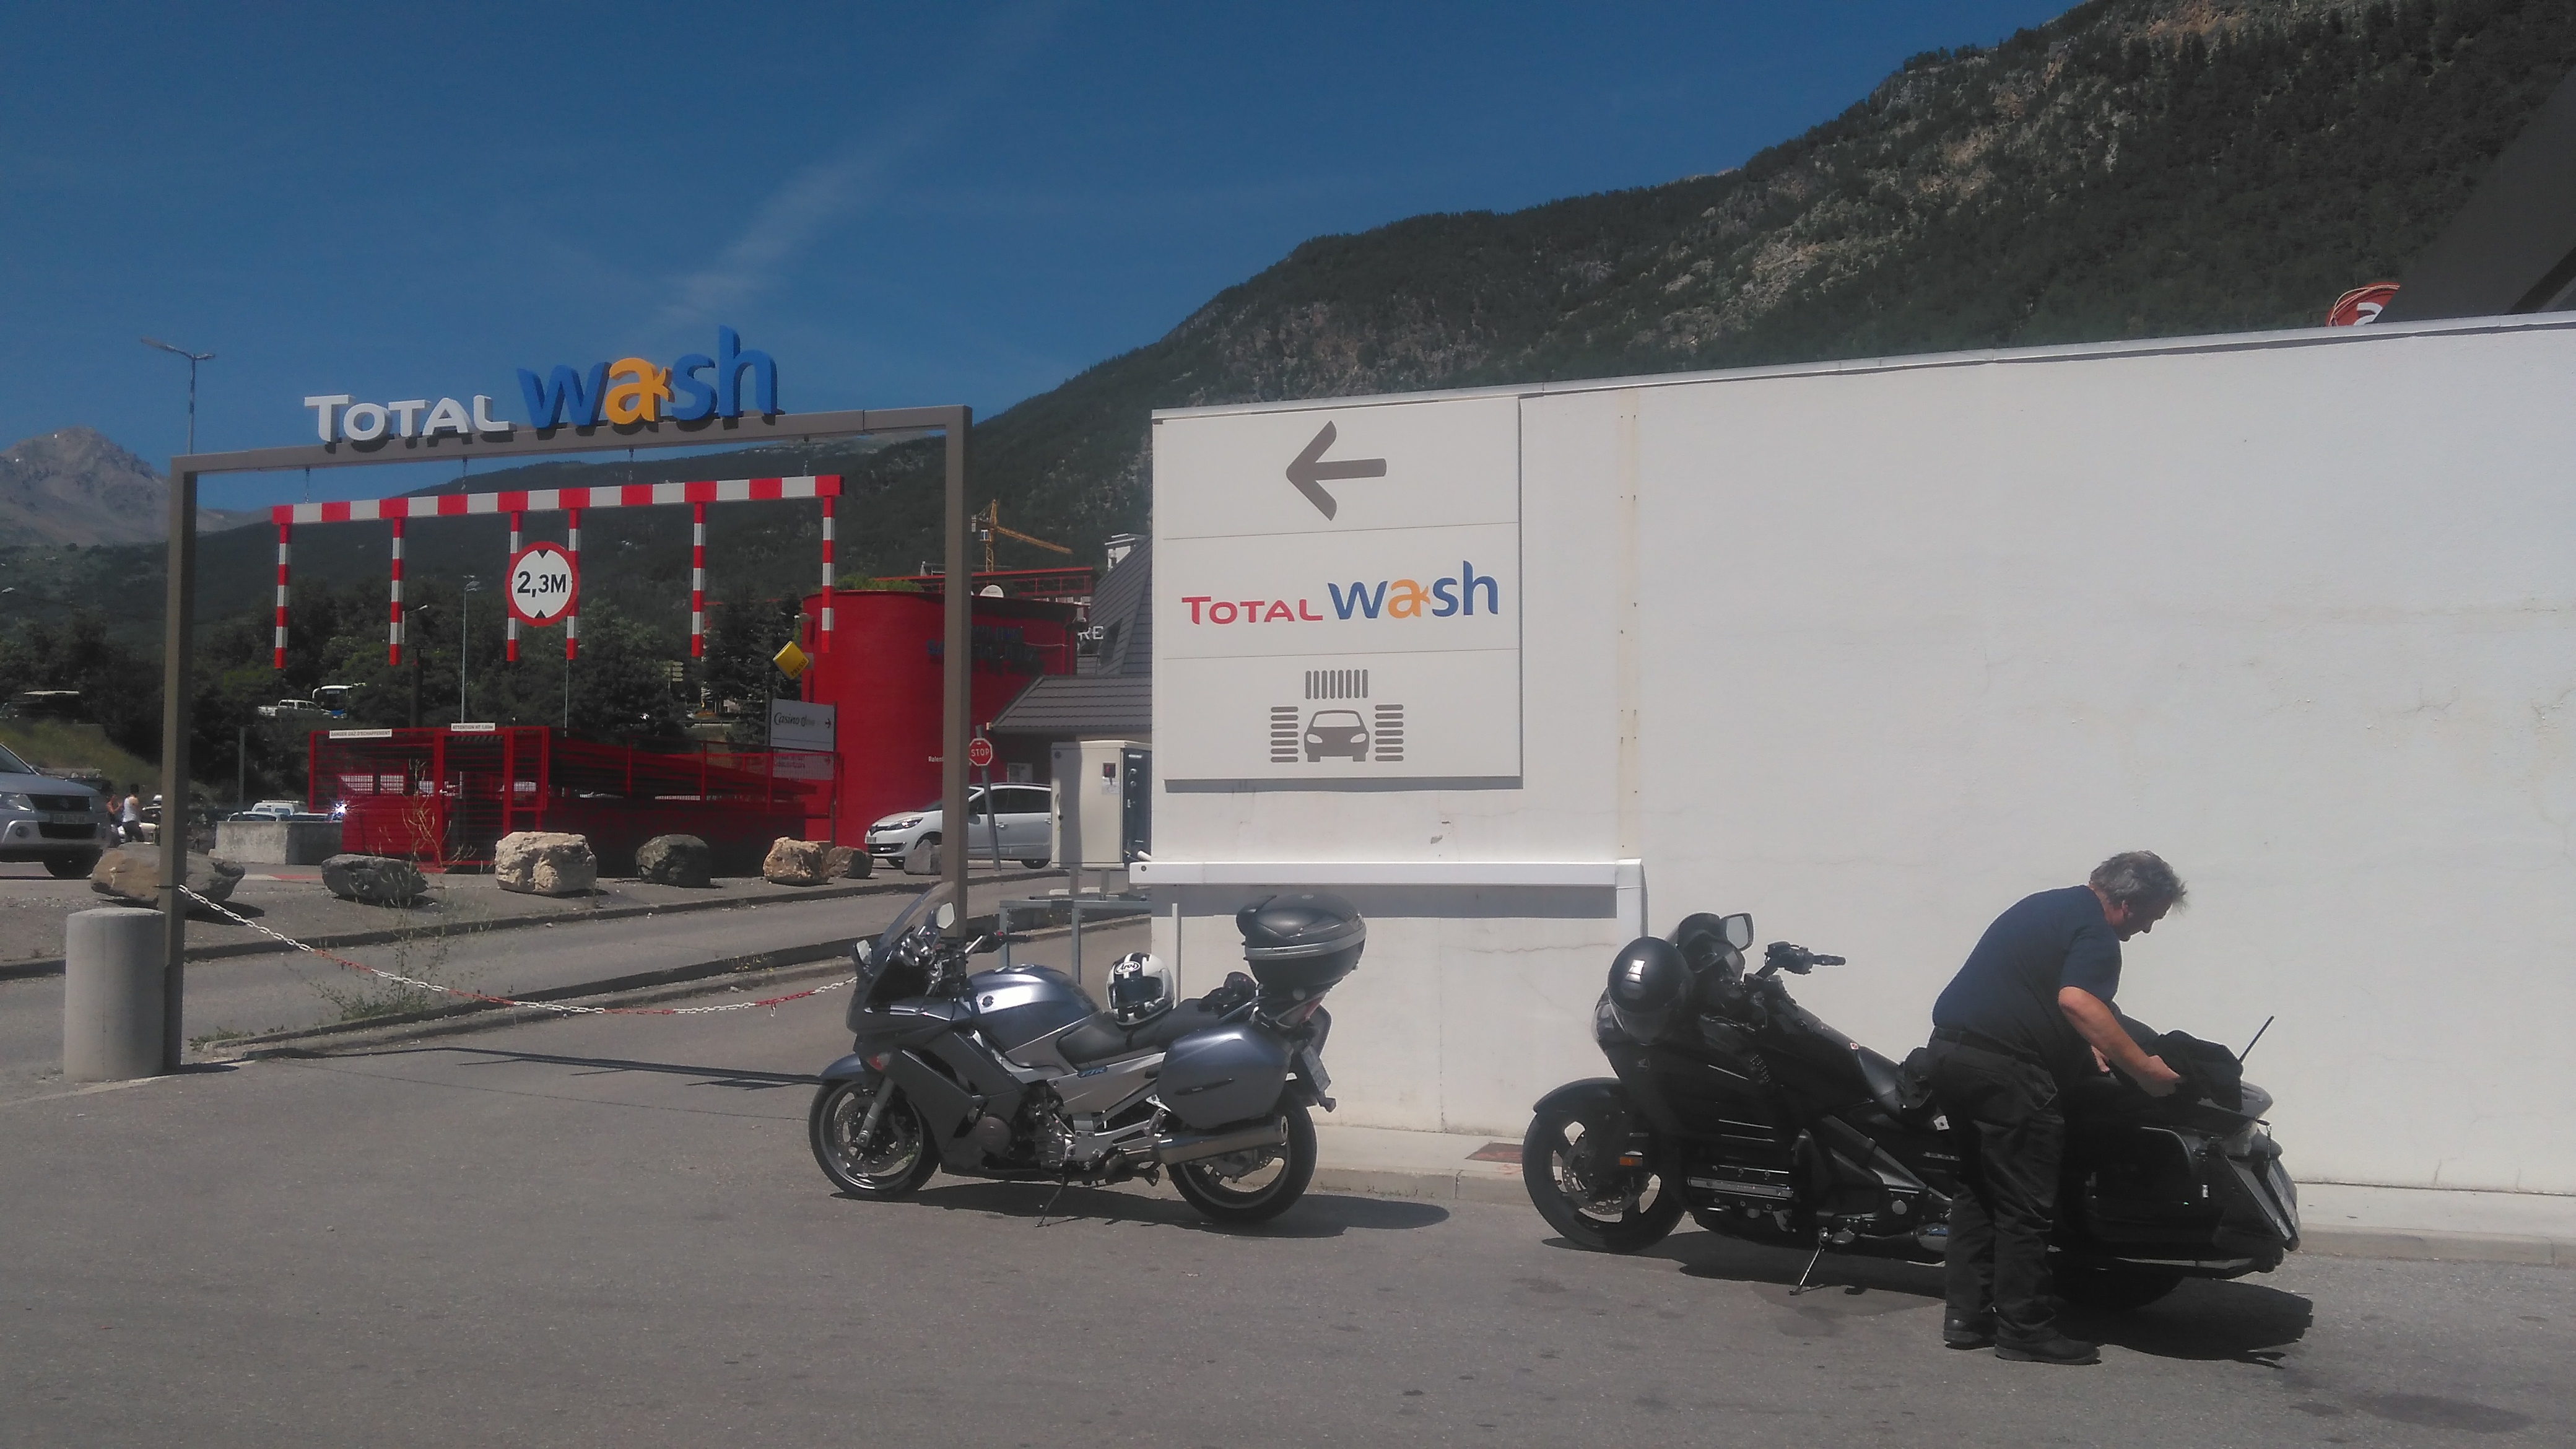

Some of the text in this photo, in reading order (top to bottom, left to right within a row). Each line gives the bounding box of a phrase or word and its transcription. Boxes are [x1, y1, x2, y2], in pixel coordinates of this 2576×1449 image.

[304, 325, 777, 443] TOTAL wash
[517, 570, 566, 598] 2,3M
[1181, 560, 1499, 625] TOTAL wash
[790, 658, 807, 676] PRESSE
[774, 712, 800, 726] Casino
[971, 749, 990, 757] STOP
